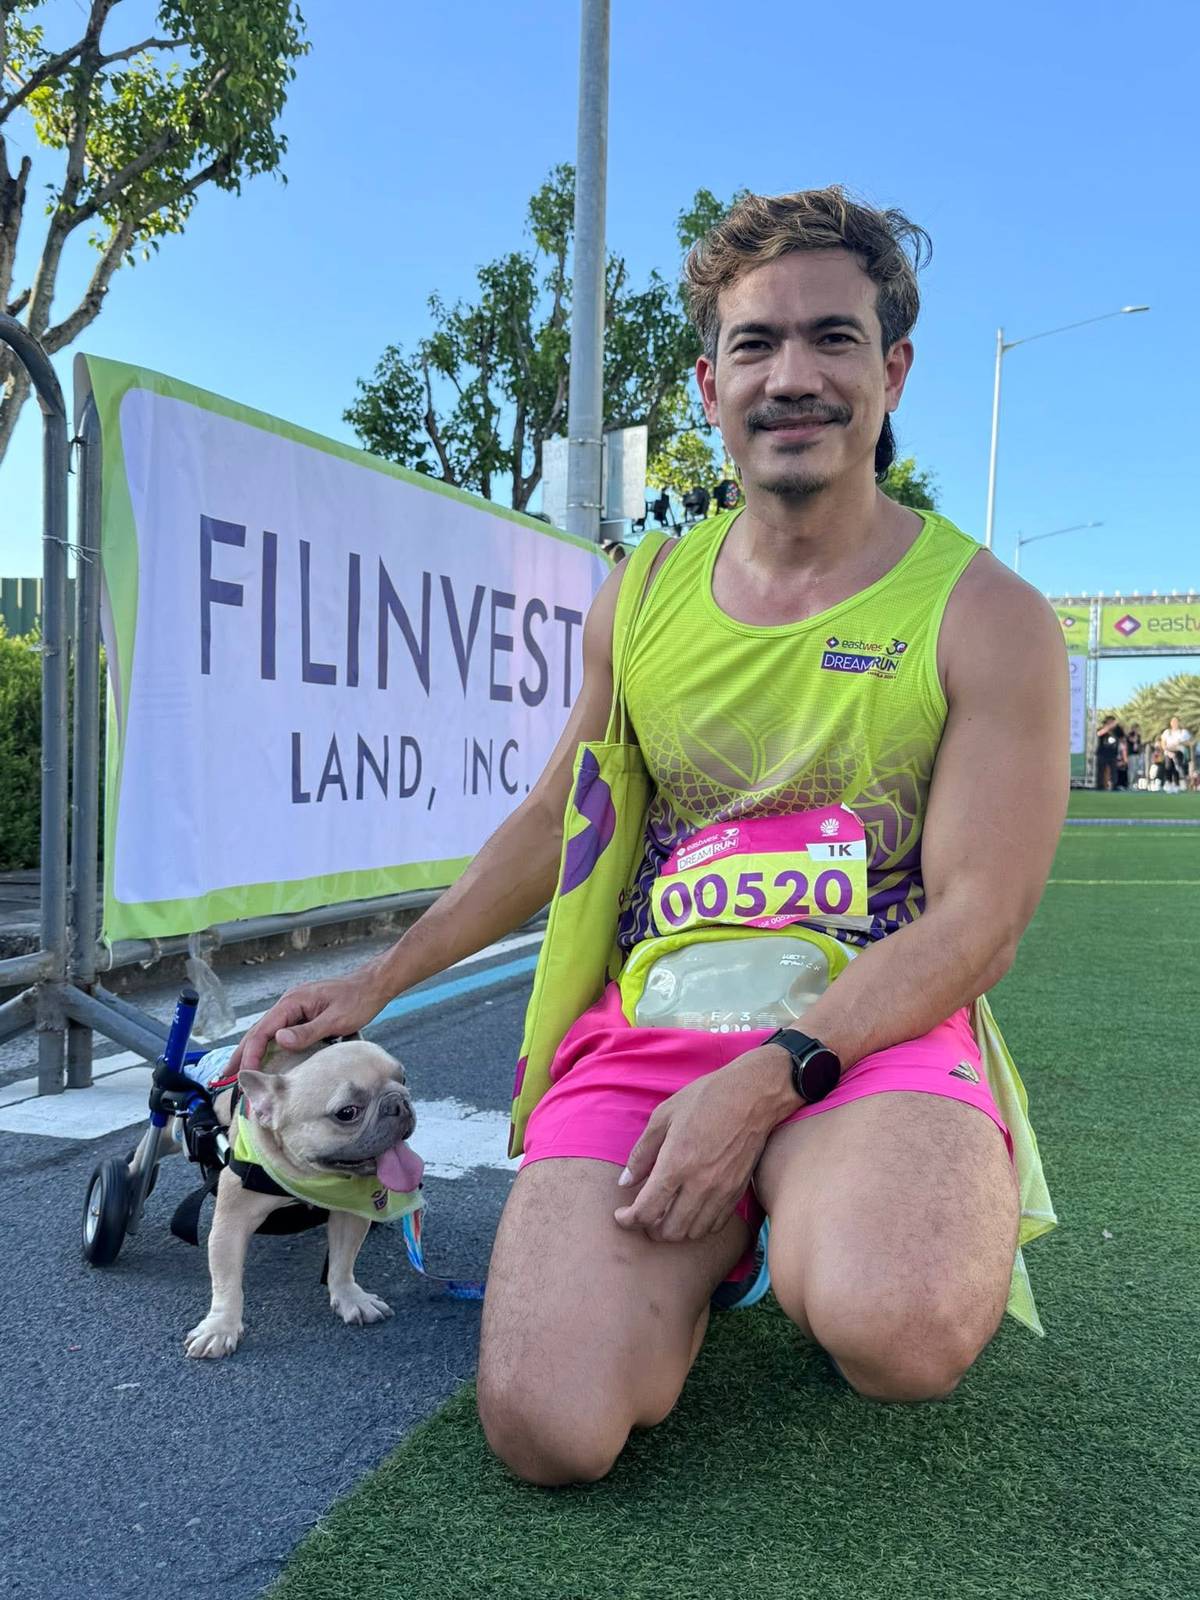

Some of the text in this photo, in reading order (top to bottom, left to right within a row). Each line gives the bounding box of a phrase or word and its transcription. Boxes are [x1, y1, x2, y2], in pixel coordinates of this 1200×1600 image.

[200, 514, 582, 708] FILINVEST
[824, 654, 899, 671] DREAM RUN
[291, 731, 530, 811] LAND, INC.
[679, 838, 737, 869] DREAM RUN
[828, 844, 852, 857] 1K
[660, 869, 853, 927] 00520
